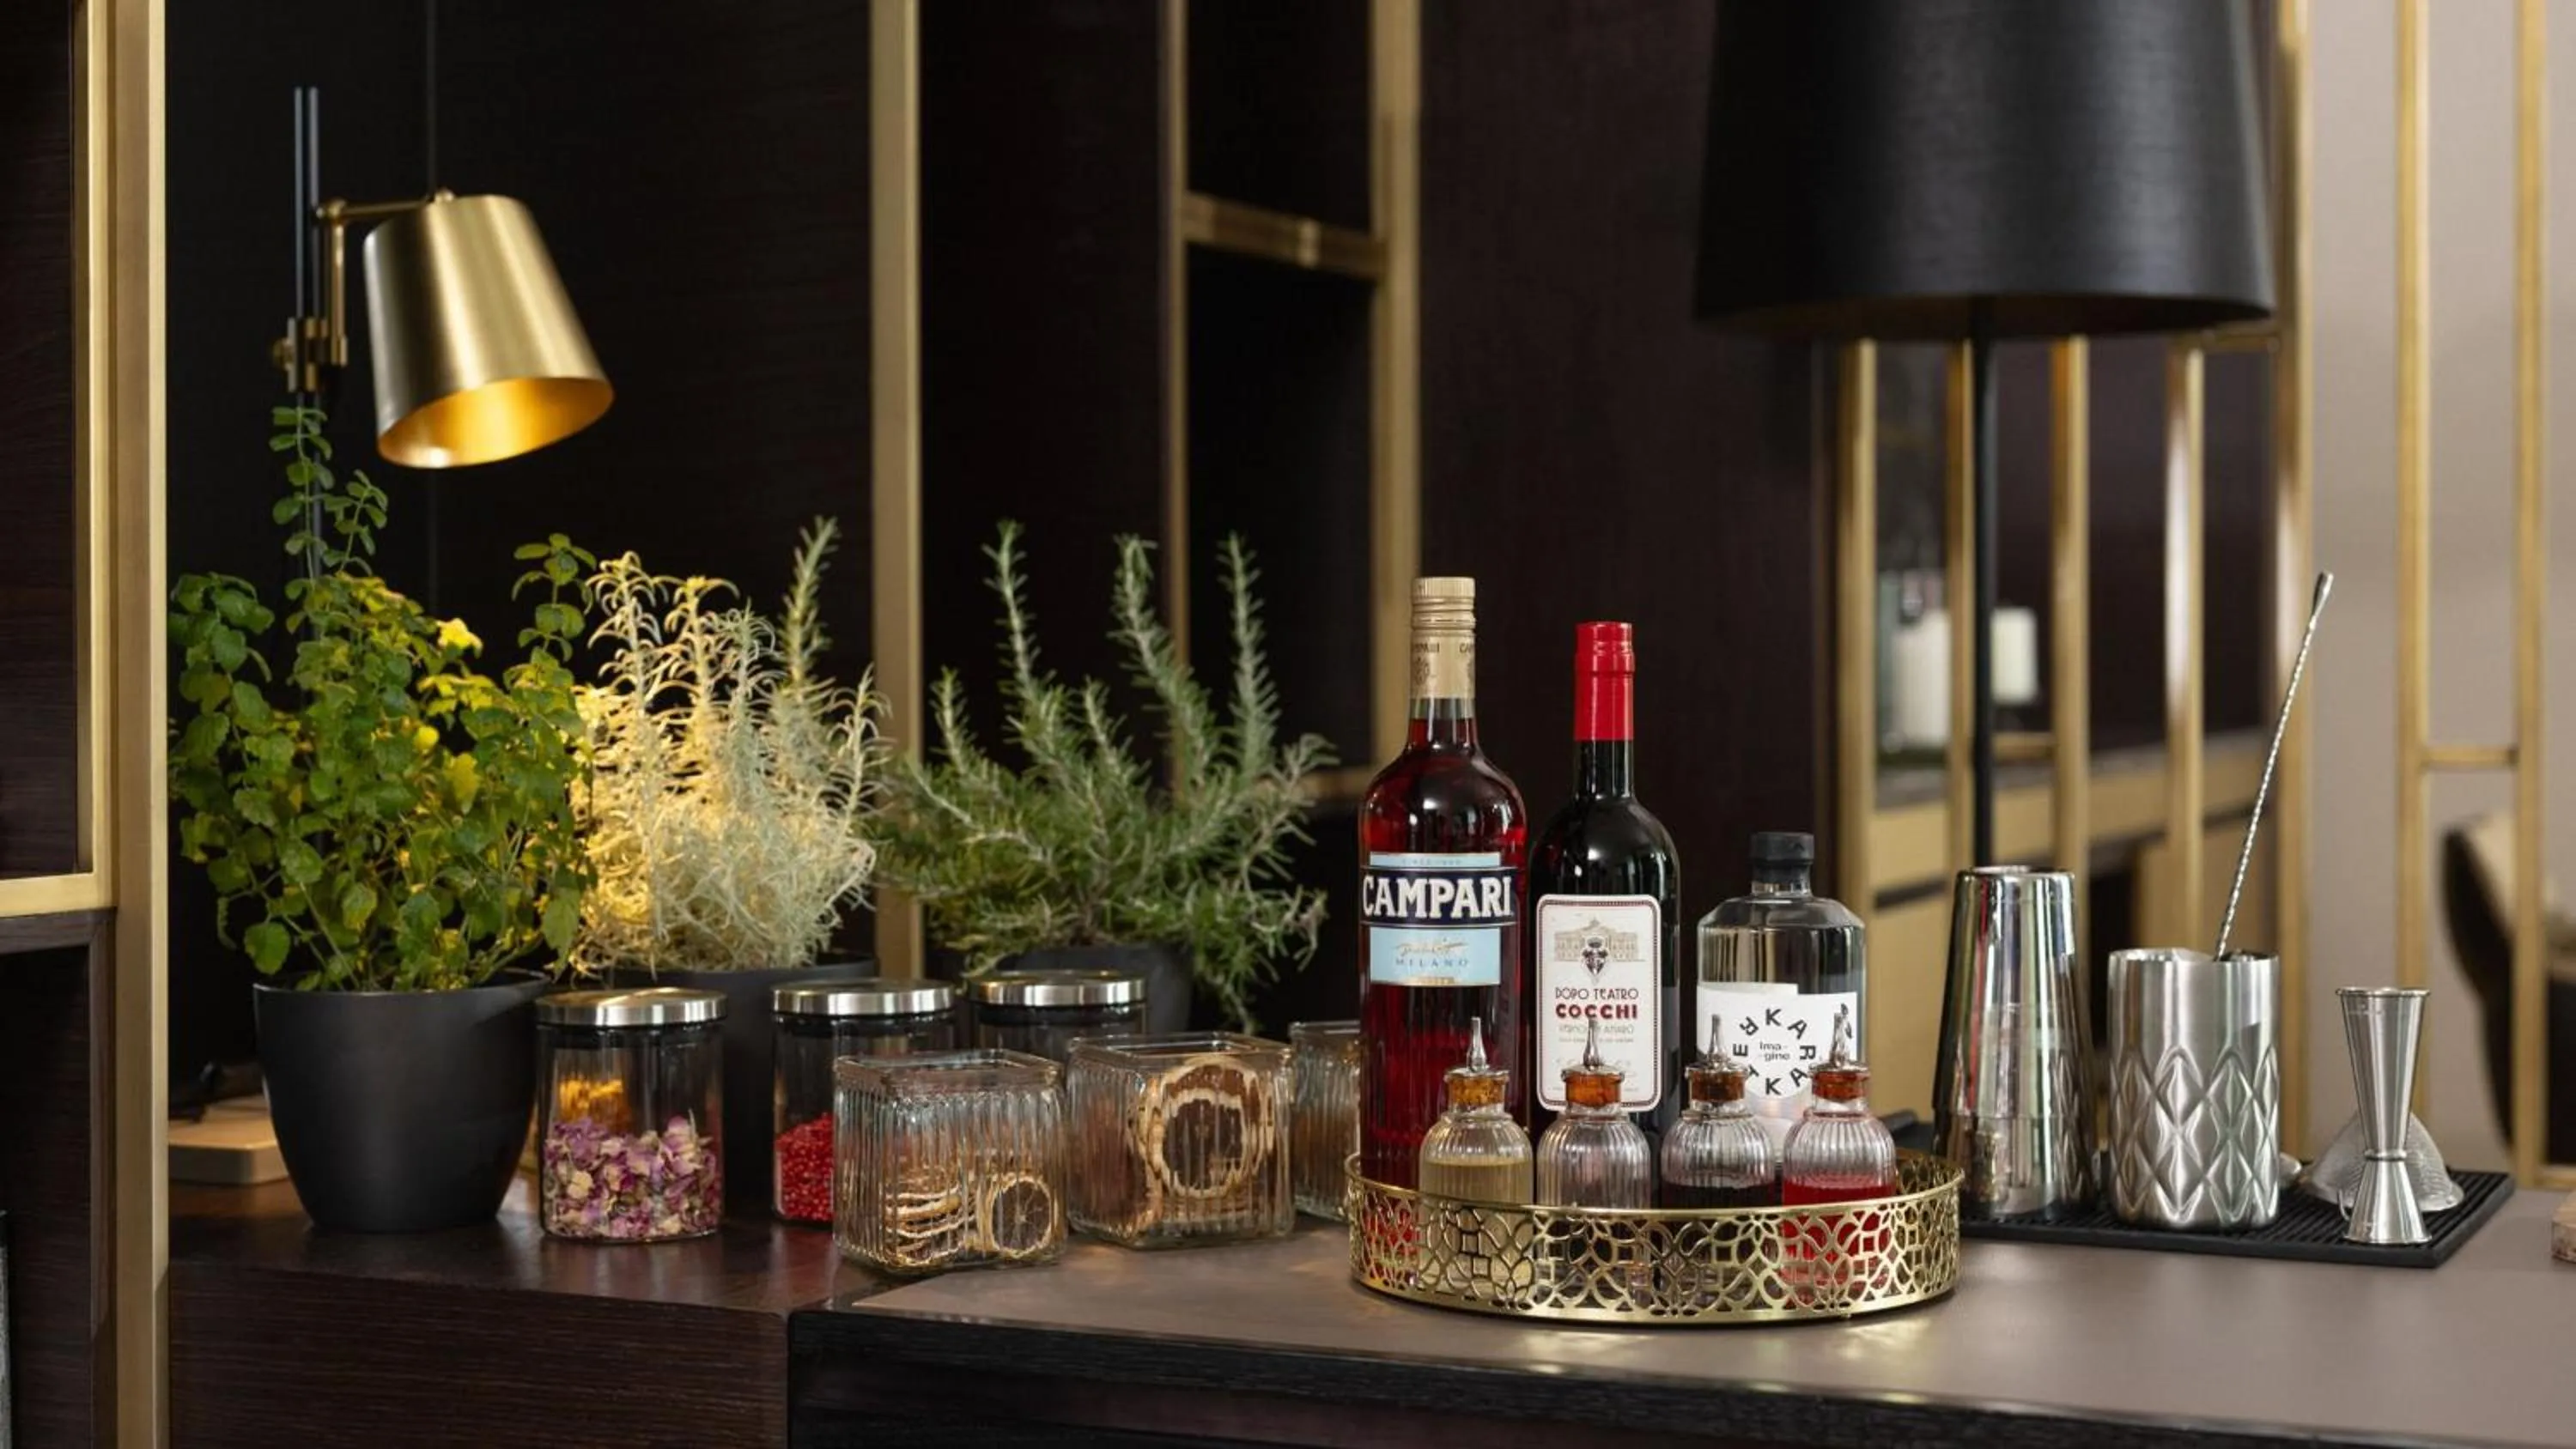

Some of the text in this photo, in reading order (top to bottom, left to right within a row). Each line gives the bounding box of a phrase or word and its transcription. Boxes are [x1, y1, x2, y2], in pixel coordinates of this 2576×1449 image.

[1363, 875, 1512, 919] CAMPARI
[1395, 958, 1468, 967] MILANO
[1555, 987, 1639, 999] DOPO TEATRO
[1556, 1003, 1637, 1019] COCCHI
